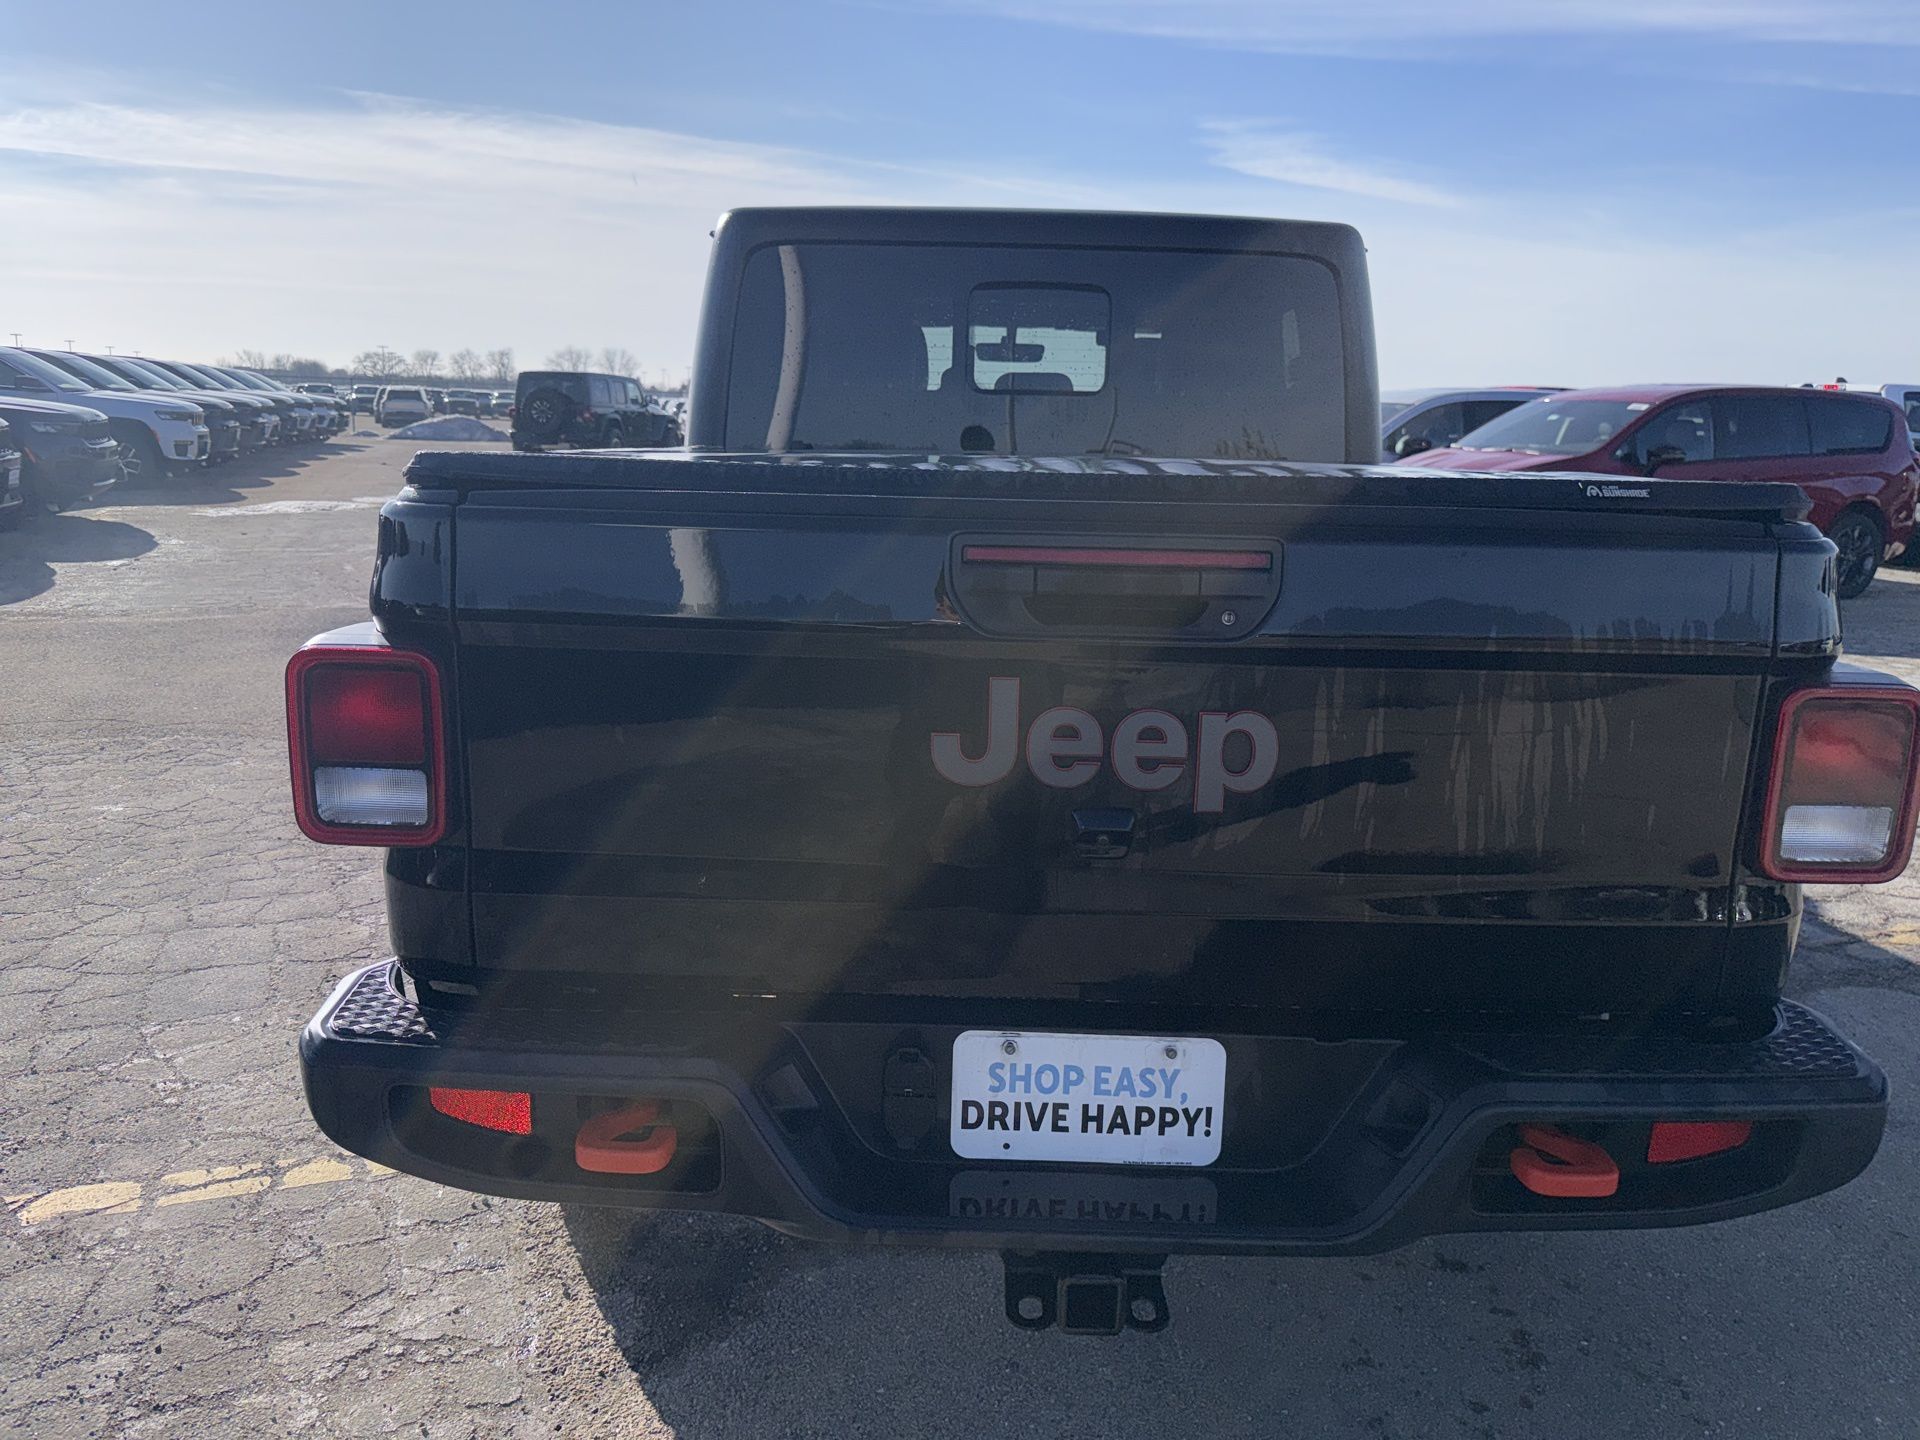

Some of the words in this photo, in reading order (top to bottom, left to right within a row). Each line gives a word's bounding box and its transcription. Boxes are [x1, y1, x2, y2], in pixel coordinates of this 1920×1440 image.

[930, 677, 1279, 813] Jeep
[987, 1062, 1085, 1095] SHOP
[1092, 1066, 1188, 1105] EASY,
[960, 1100, 1069, 1133] DRIVE
[1080, 1104, 1213, 1137] HAPPY!
